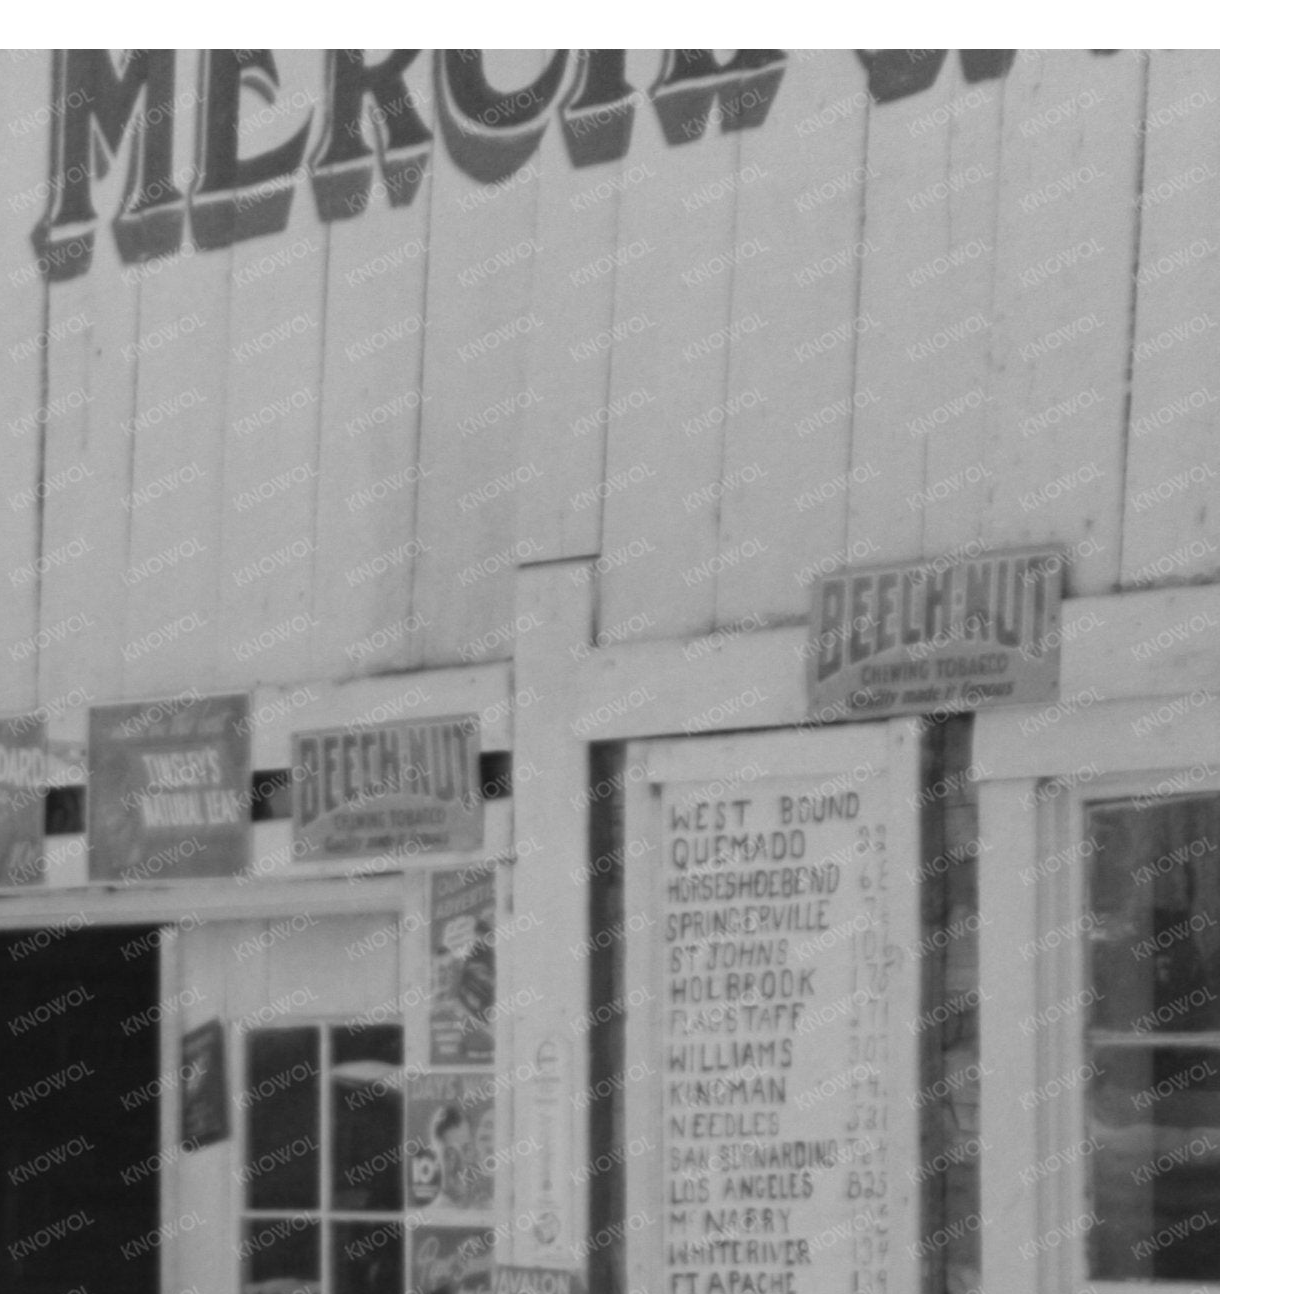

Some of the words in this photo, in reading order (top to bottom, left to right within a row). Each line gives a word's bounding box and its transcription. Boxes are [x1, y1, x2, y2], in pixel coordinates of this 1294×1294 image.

[936, 652, 1009, 679] TOBACCO
[671, 799, 751, 831] WEST
[781, 791, 860, 825] BOUND
[672, 829, 806, 870] QUEMADO
[666, 900, 831, 943] SPRINGERVILLE
[706, 938, 789, 971] JOHNS
[671, 968, 817, 1003] HOLBROOK
[669, 1038, 793, 1072] WILLIAMS
[669, 1076, 787, 1106] KINGMAN
[670, 1111, 781, 1139] NEEDLES
[670, 1178, 710, 1204] LOS
[723, 1172, 814, 1201] ANGELES
[668, 1238, 811, 1267] WHITERIVER
